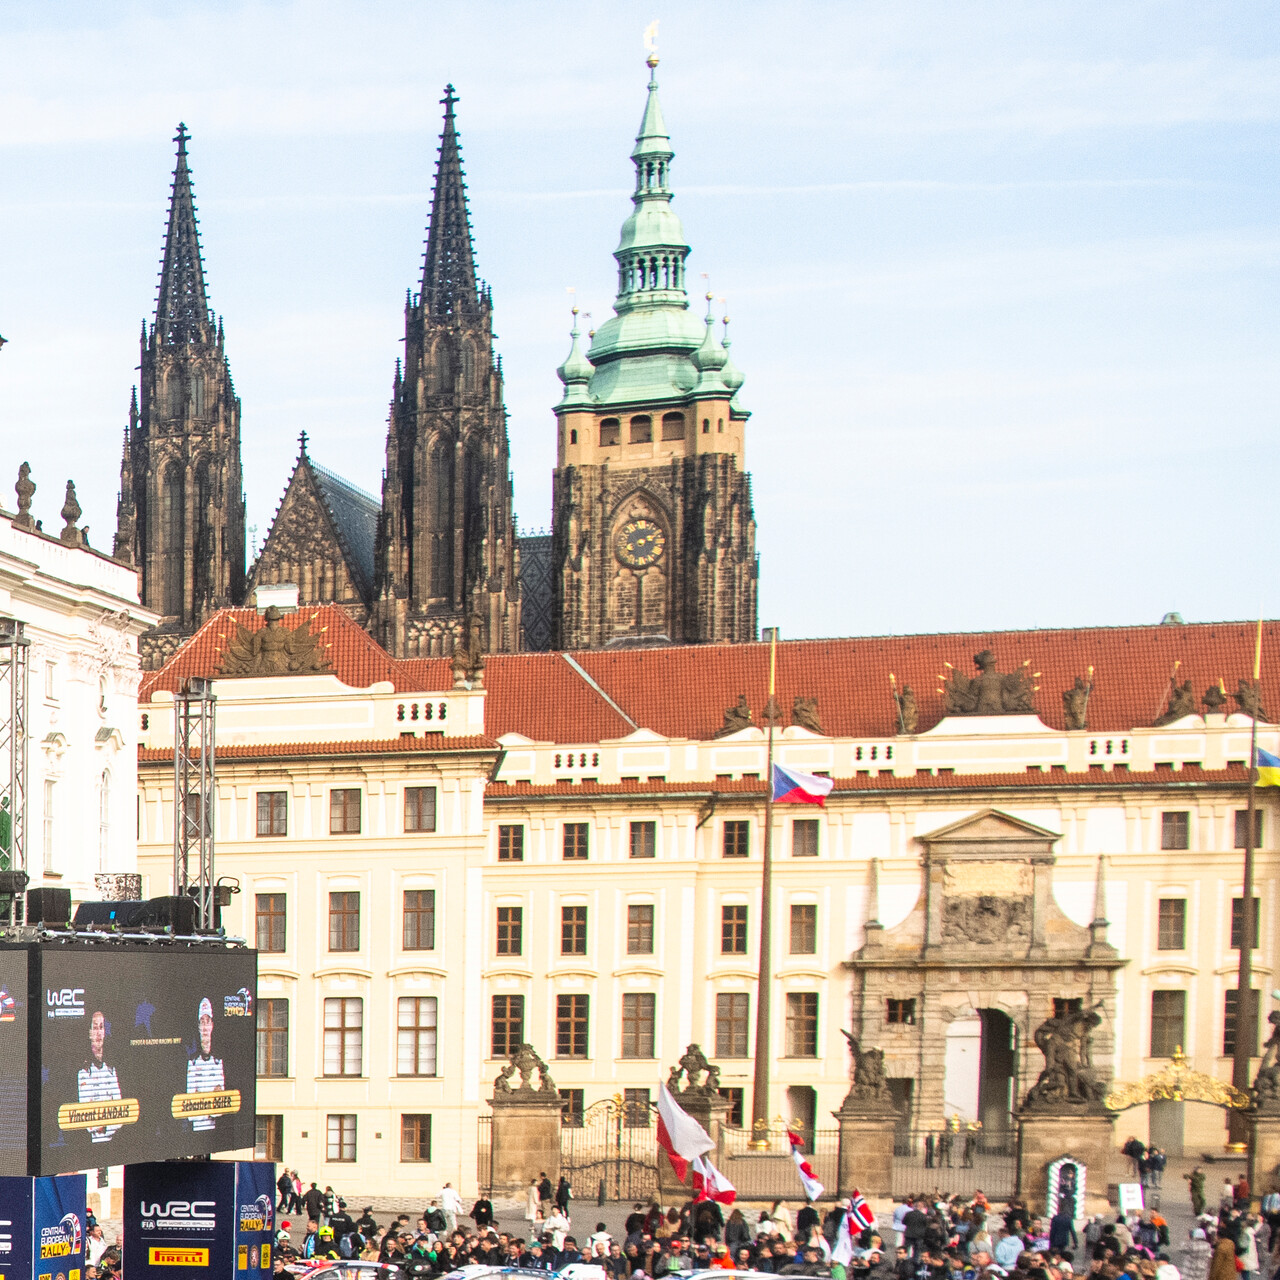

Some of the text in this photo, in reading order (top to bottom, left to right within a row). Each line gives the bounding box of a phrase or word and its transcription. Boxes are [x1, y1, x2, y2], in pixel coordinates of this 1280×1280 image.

[47, 989, 85, 1006] WRC
[68, 1105, 130, 1123] Vincent LANDAIS
[141, 1201, 216, 1218] WRC
[240, 1212, 263, 1220] EUROPEAN
[142, 1220, 155, 1230] FIA
[240, 1220, 260, 1231] RALLY
[41, 1226, 65, 1236] CENTRAL
[40, 1234, 70, 1246] EUROPEAN
[40, 1245, 66, 1259] RALLY
[155, 1251, 203, 1262] PIRELLI
